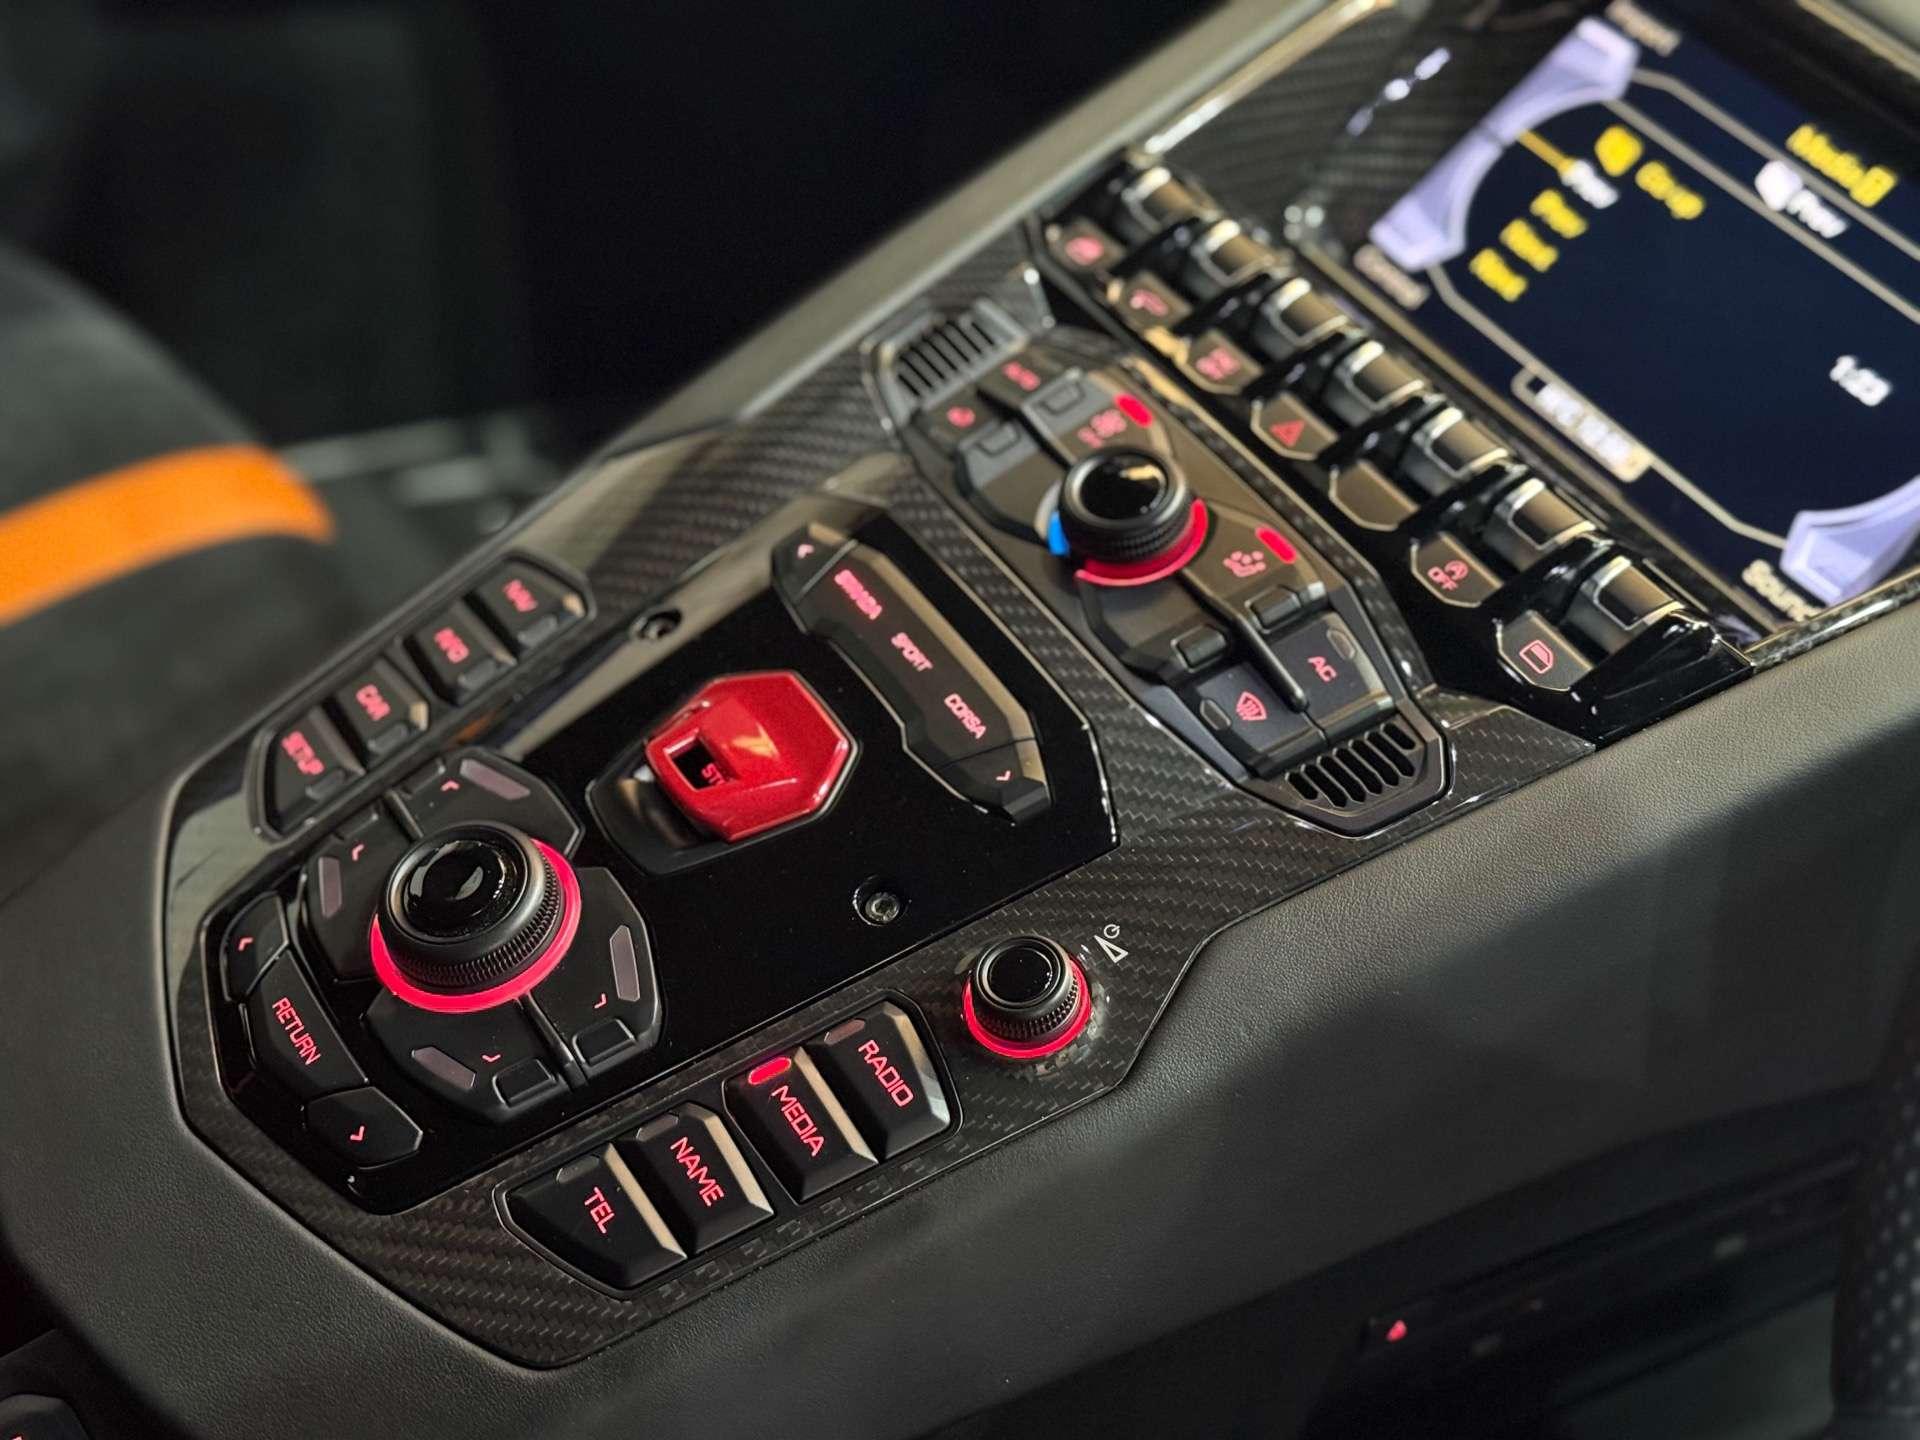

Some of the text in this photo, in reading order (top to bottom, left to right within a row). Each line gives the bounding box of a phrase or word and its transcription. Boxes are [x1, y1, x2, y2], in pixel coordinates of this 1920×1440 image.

[891, 632, 933, 671] SPORT
[1308, 656, 1337, 682] AC
[944, 694, 986, 739] CORSA
[701, 763, 727, 785] ST
[271, 997, 321, 1065] RETURN
[858, 1039, 914, 1108] RADIO
[770, 1085, 826, 1157] MEDIA
[669, 1136, 725, 1207] NAME
[584, 1186, 615, 1235] TEL
